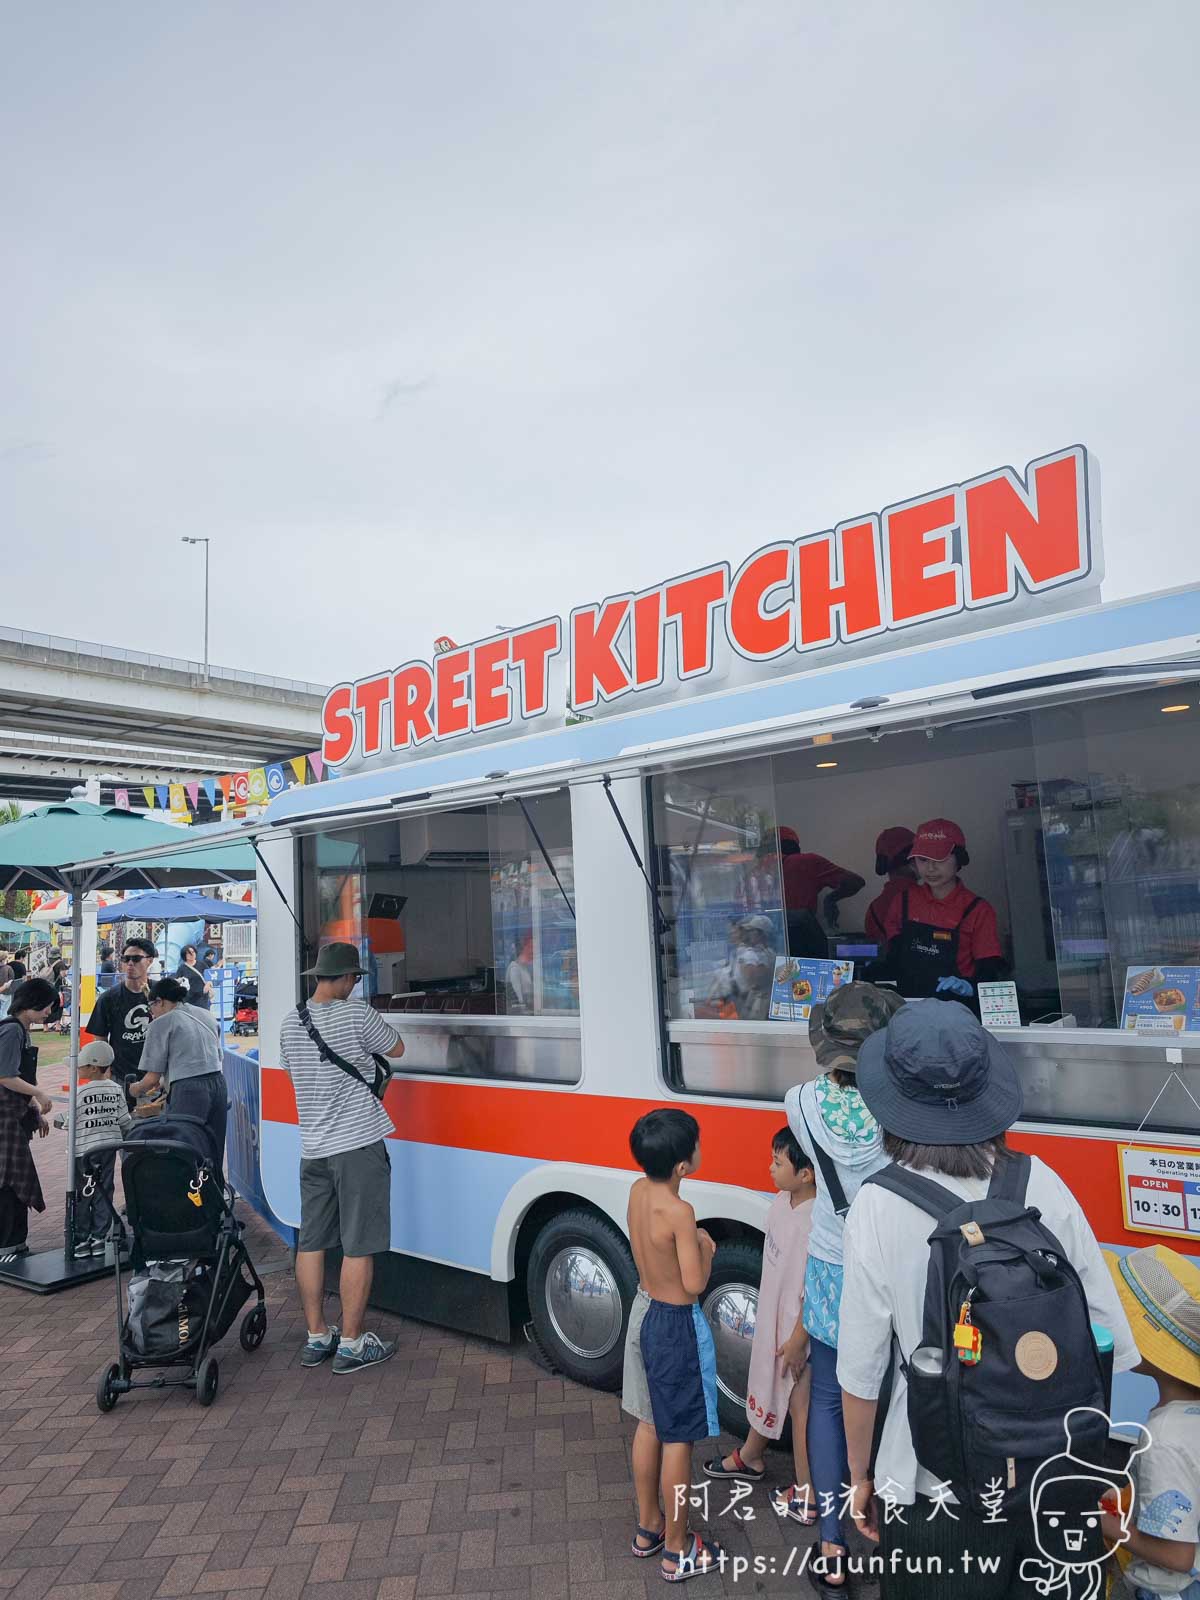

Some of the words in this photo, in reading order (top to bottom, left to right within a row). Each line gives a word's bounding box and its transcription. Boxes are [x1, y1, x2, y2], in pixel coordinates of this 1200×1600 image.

[321, 622, 558, 764] STREET
[573, 454, 1081, 707] KITCHEN
[1156, 1168, 1189, 1178] Operating
[1141, 1179, 1169, 1190] OPEN
